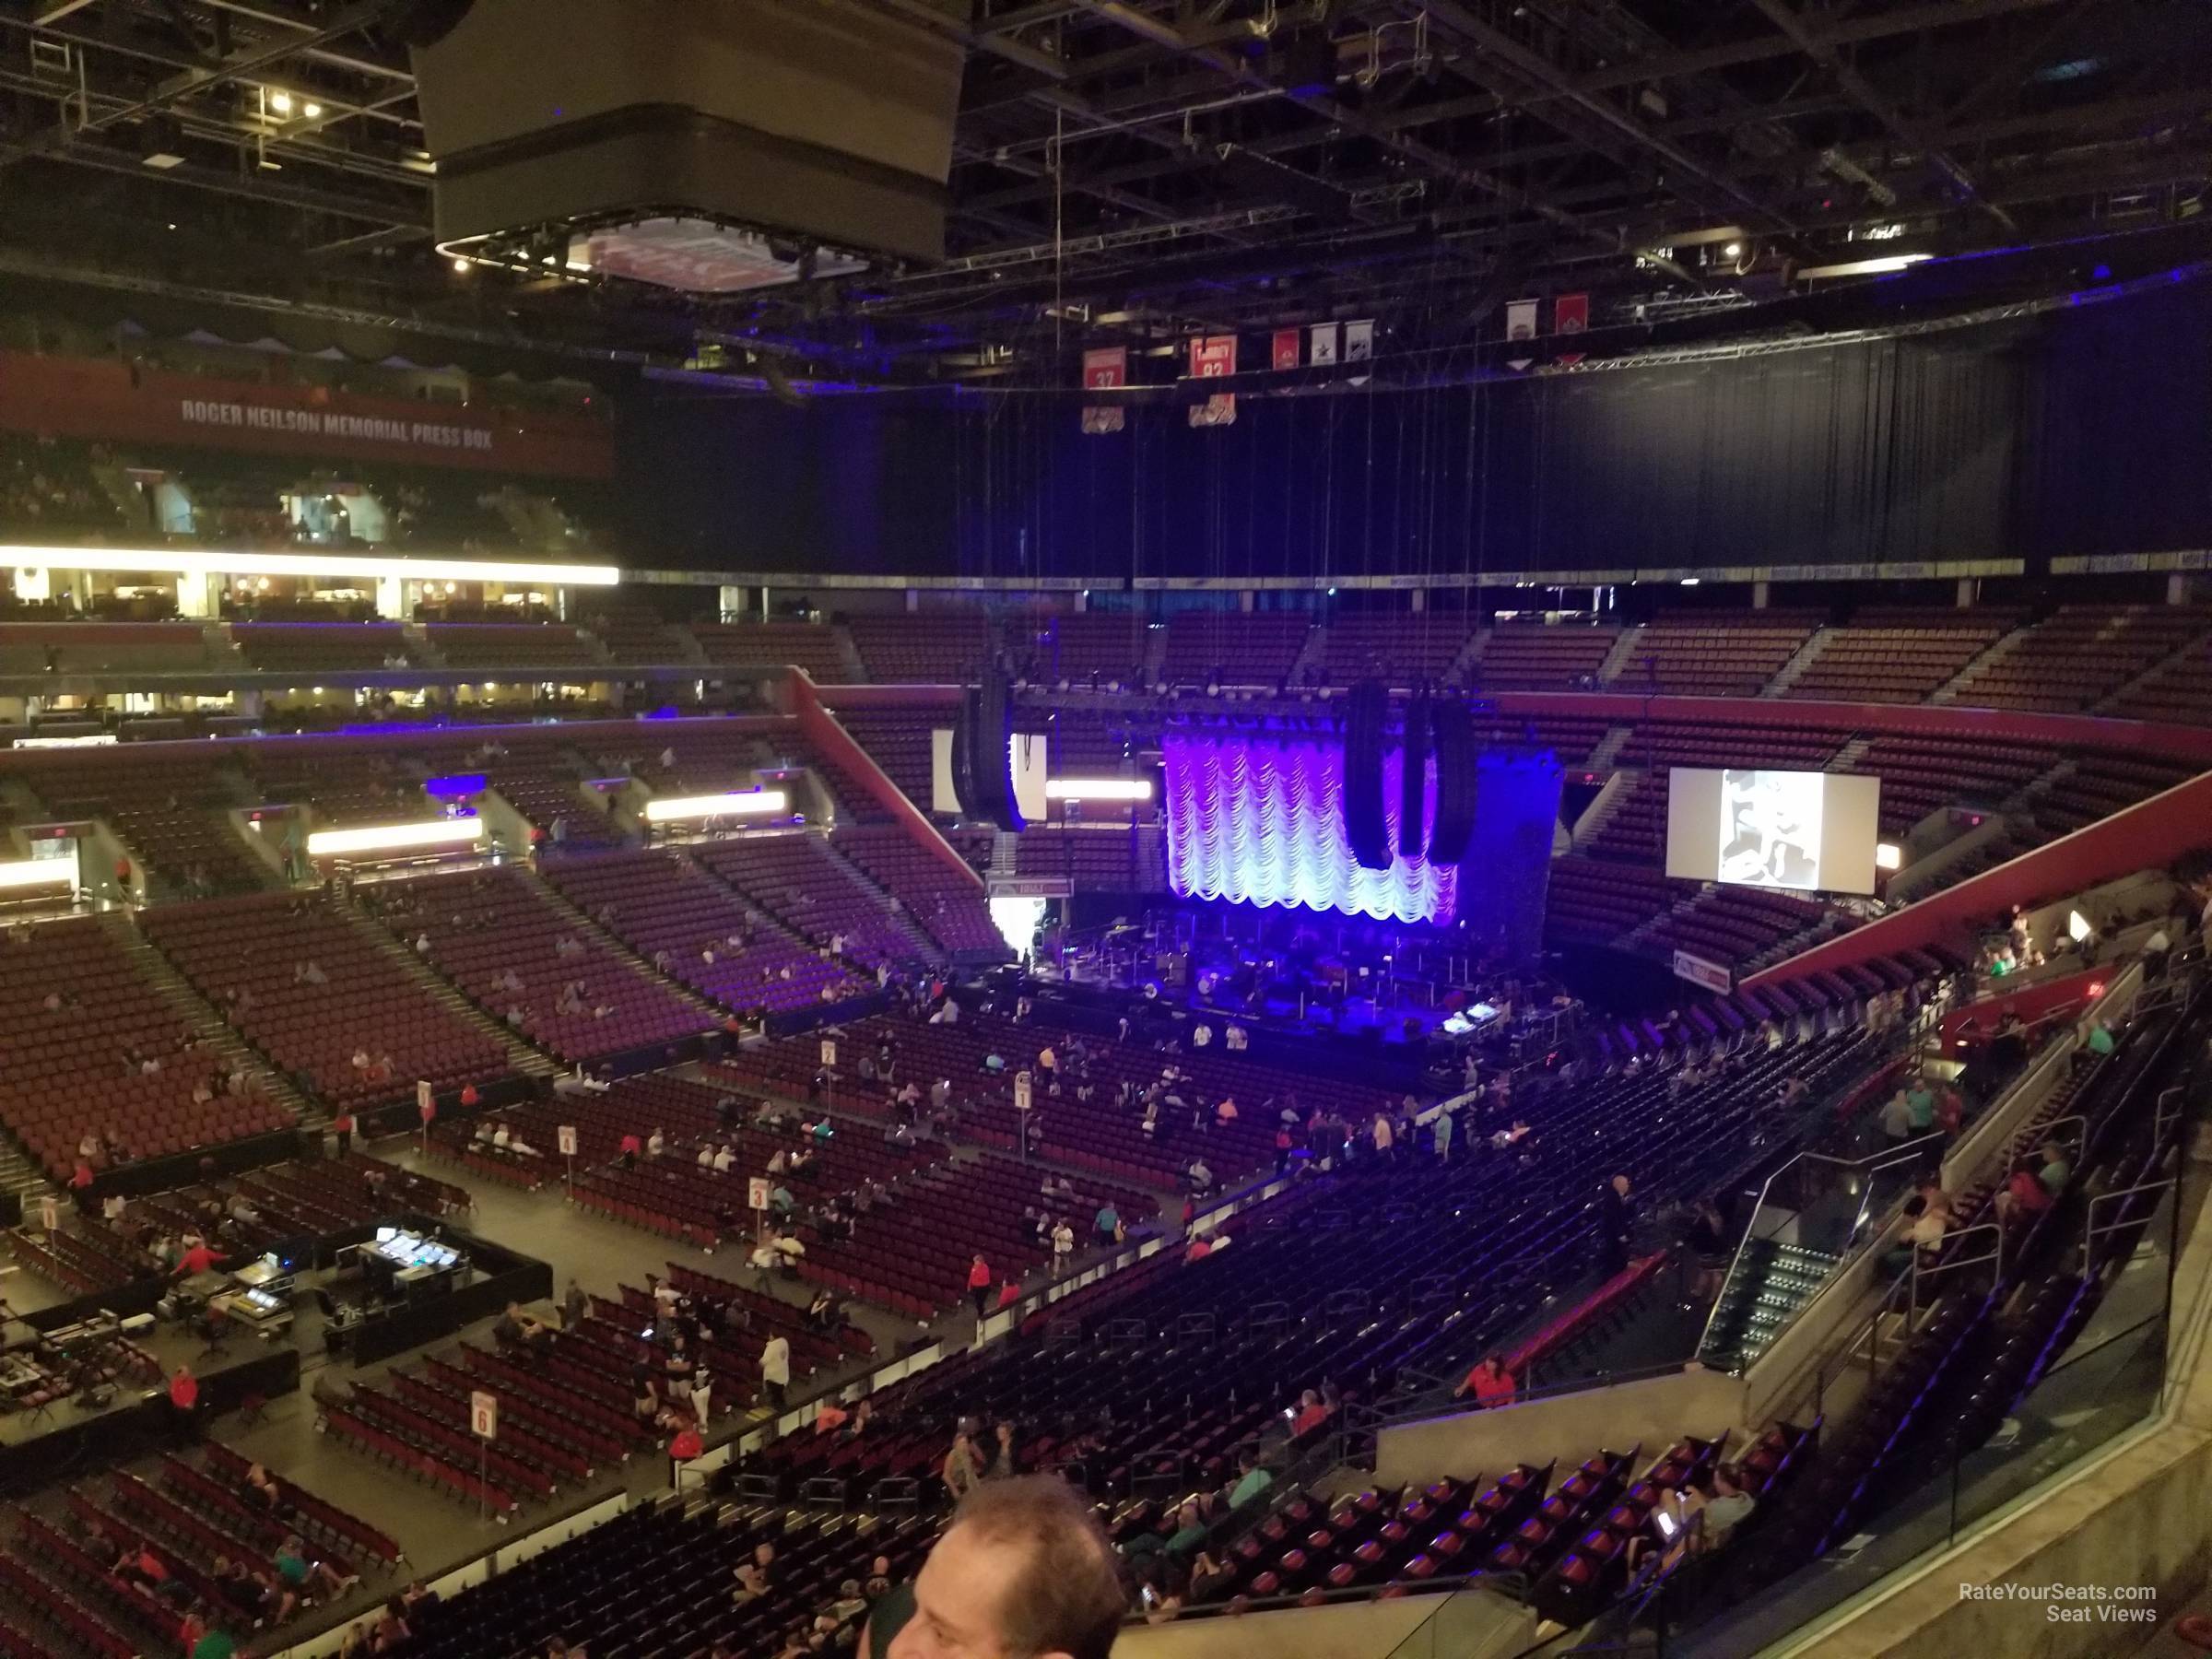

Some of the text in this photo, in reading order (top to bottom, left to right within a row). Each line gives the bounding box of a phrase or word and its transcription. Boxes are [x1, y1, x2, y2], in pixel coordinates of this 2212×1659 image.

[182, 400, 492, 449] ROGER NEILSON MEMORIAL PRESS BOX
[754, 1190, 762, 1206] 3
[477, 1410, 488, 1433] 6
